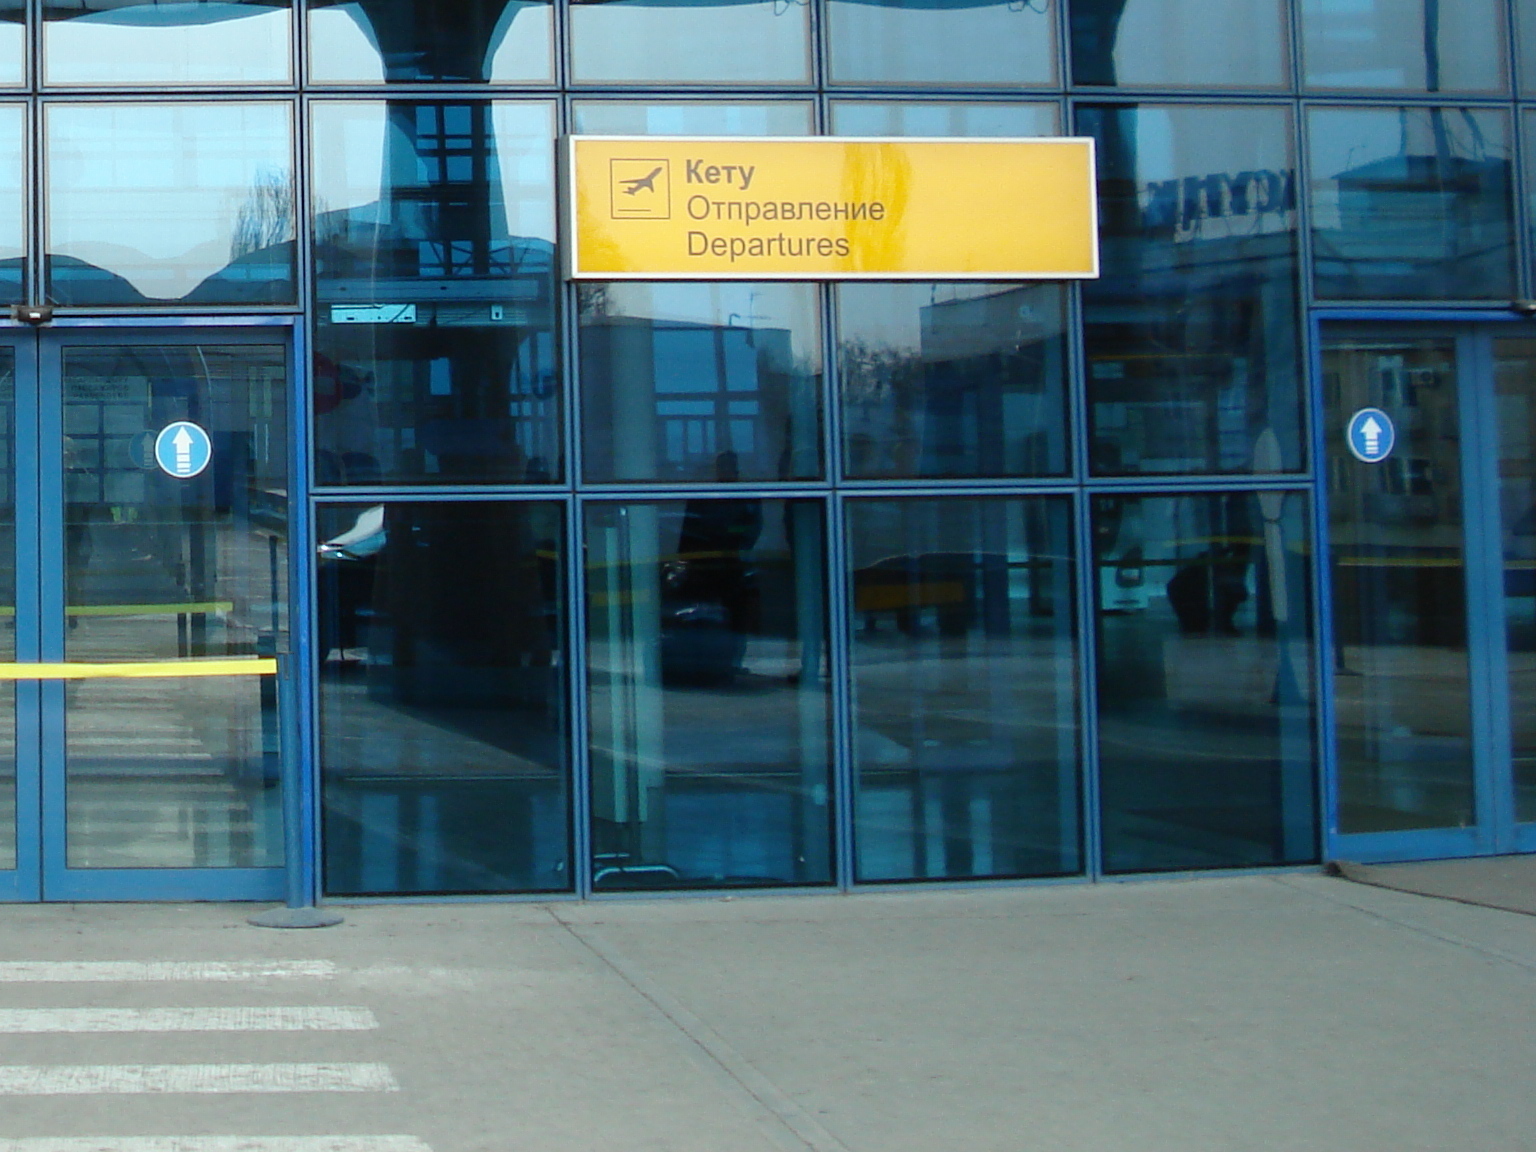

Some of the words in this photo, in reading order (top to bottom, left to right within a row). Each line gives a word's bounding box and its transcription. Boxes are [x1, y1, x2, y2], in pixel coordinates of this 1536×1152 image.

[685, 159, 755, 191] Кету
[687, 195, 885, 227] Отправление
[687, 231, 851, 263] Departures
